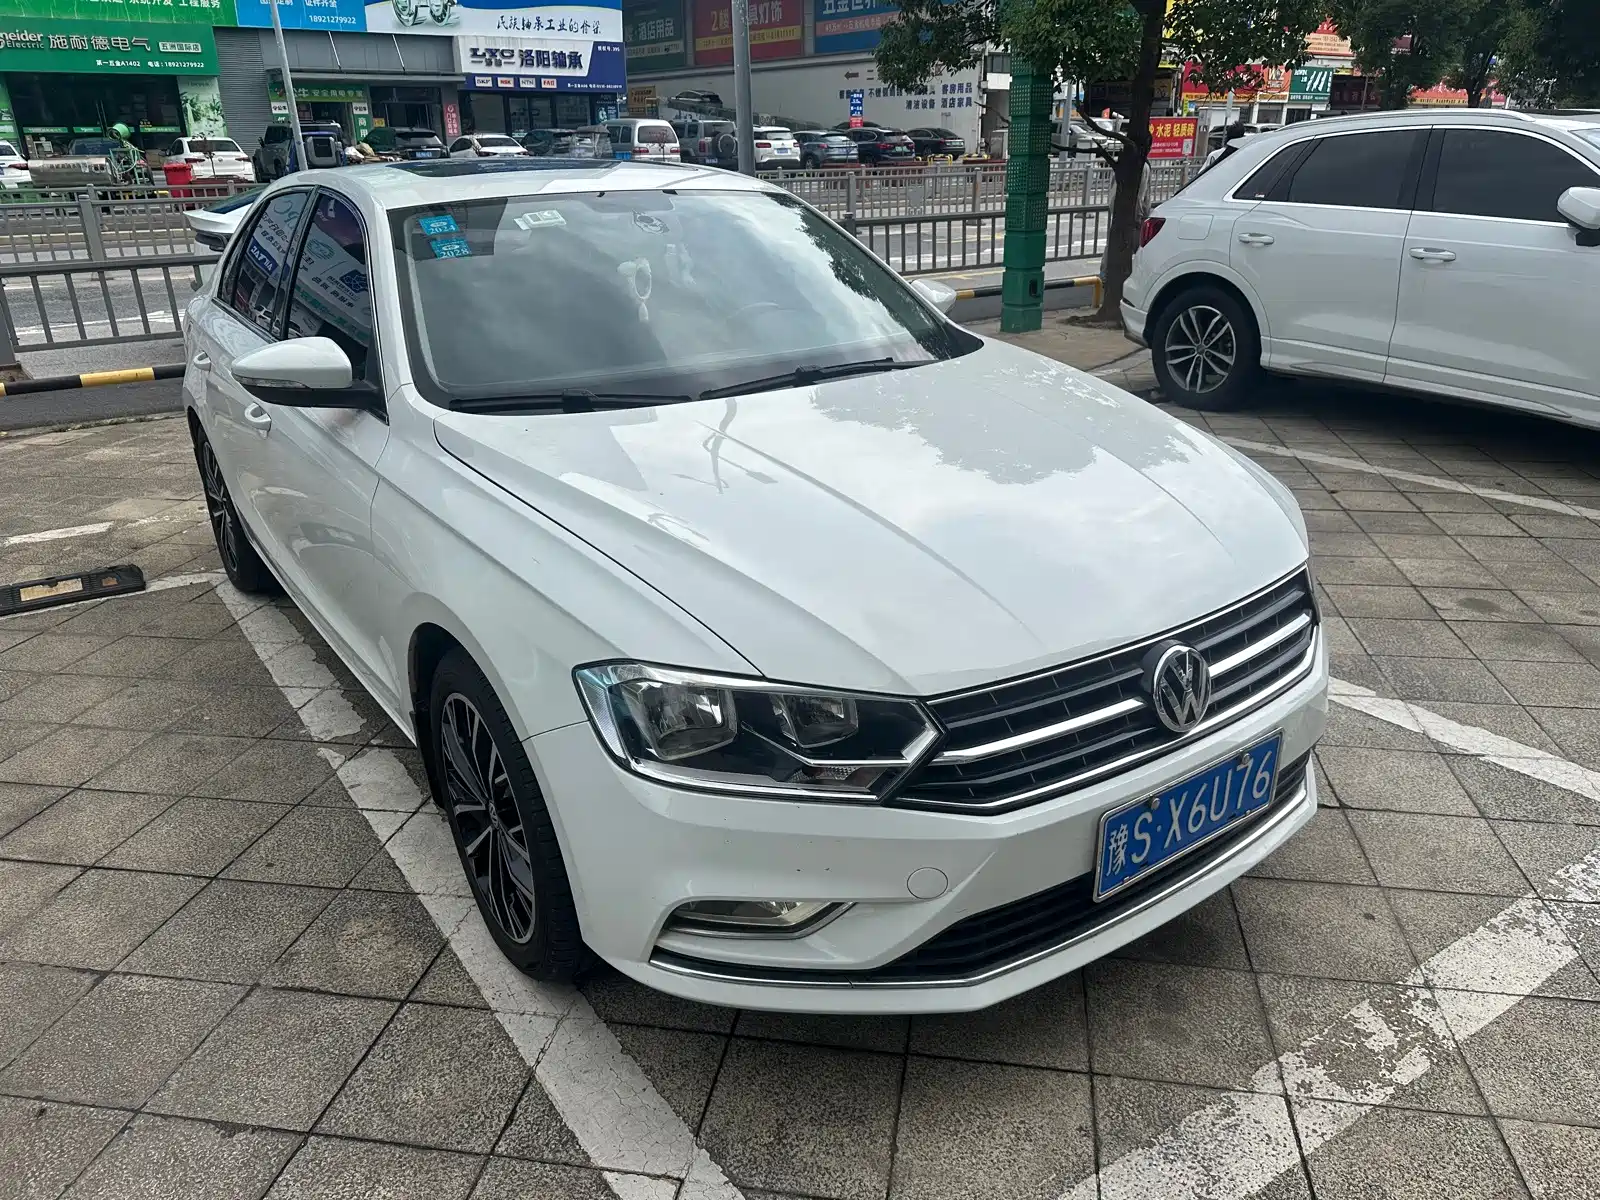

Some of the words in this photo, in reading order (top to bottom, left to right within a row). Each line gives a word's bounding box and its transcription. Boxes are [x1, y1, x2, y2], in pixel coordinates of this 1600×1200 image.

[309, 15, 356, 24] 18921279922
[748, 1, 783, 25] 具灯饰
[639, 17, 675, 40] 酒店用品
[7, 41, 44, 49] Electric
[48, 34, 151, 51] 施耐德电气
[161, 43, 200, 52] 五洲国际店
[469, 48, 515, 58] LYC
[520, 49, 584, 69] 洛阳轴承
[521, 79, 535, 87] NTN
[941, 82, 973, 95] 客房用品
[941, 96, 973, 109] 酒店家具
[1155, 123, 1171, 138] 水泥
[428, 224, 455, 234] 2024
[440, 248, 468, 258] 2028
[1105, 750, 1273, 877] 豫S·X6U76
